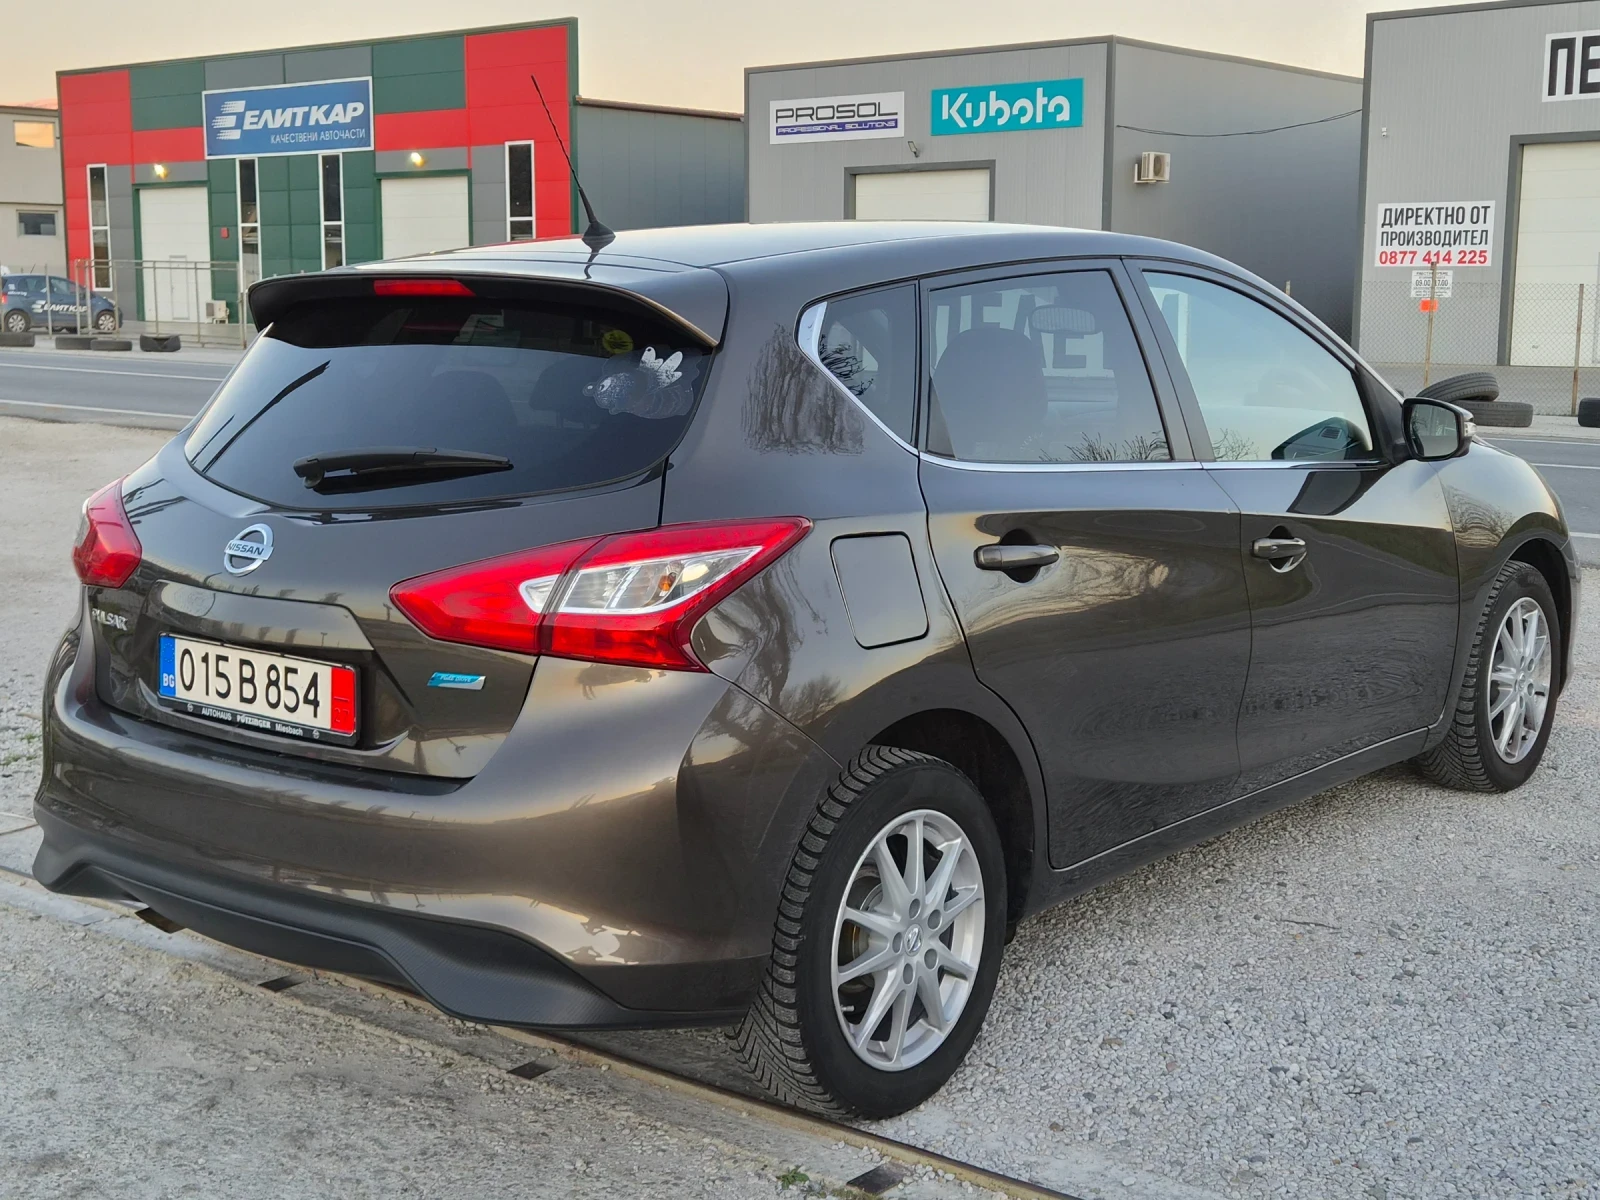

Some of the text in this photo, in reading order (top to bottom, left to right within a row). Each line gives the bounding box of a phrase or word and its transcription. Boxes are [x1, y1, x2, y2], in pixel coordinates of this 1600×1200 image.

[775, 101, 898, 123] PROSOL
[942, 87, 1070, 128] Kubota
[271, 129, 366, 144] КАЧЕСТВЕНИ АВТОЧАСТИ
[1381, 206, 1491, 228] ДИРЕКТНО ОТ
[1380, 229, 1489, 248] ПРОИЗВОДИТЕЛ
[1379, 249, 1488, 265] 0877 414 225
[228, 543, 264, 556] NISSAN
[163, 673, 175, 688] BG
[201, 707, 233, 722] AUTOHAUS
[275, 723, 304, 737] Miesbach
